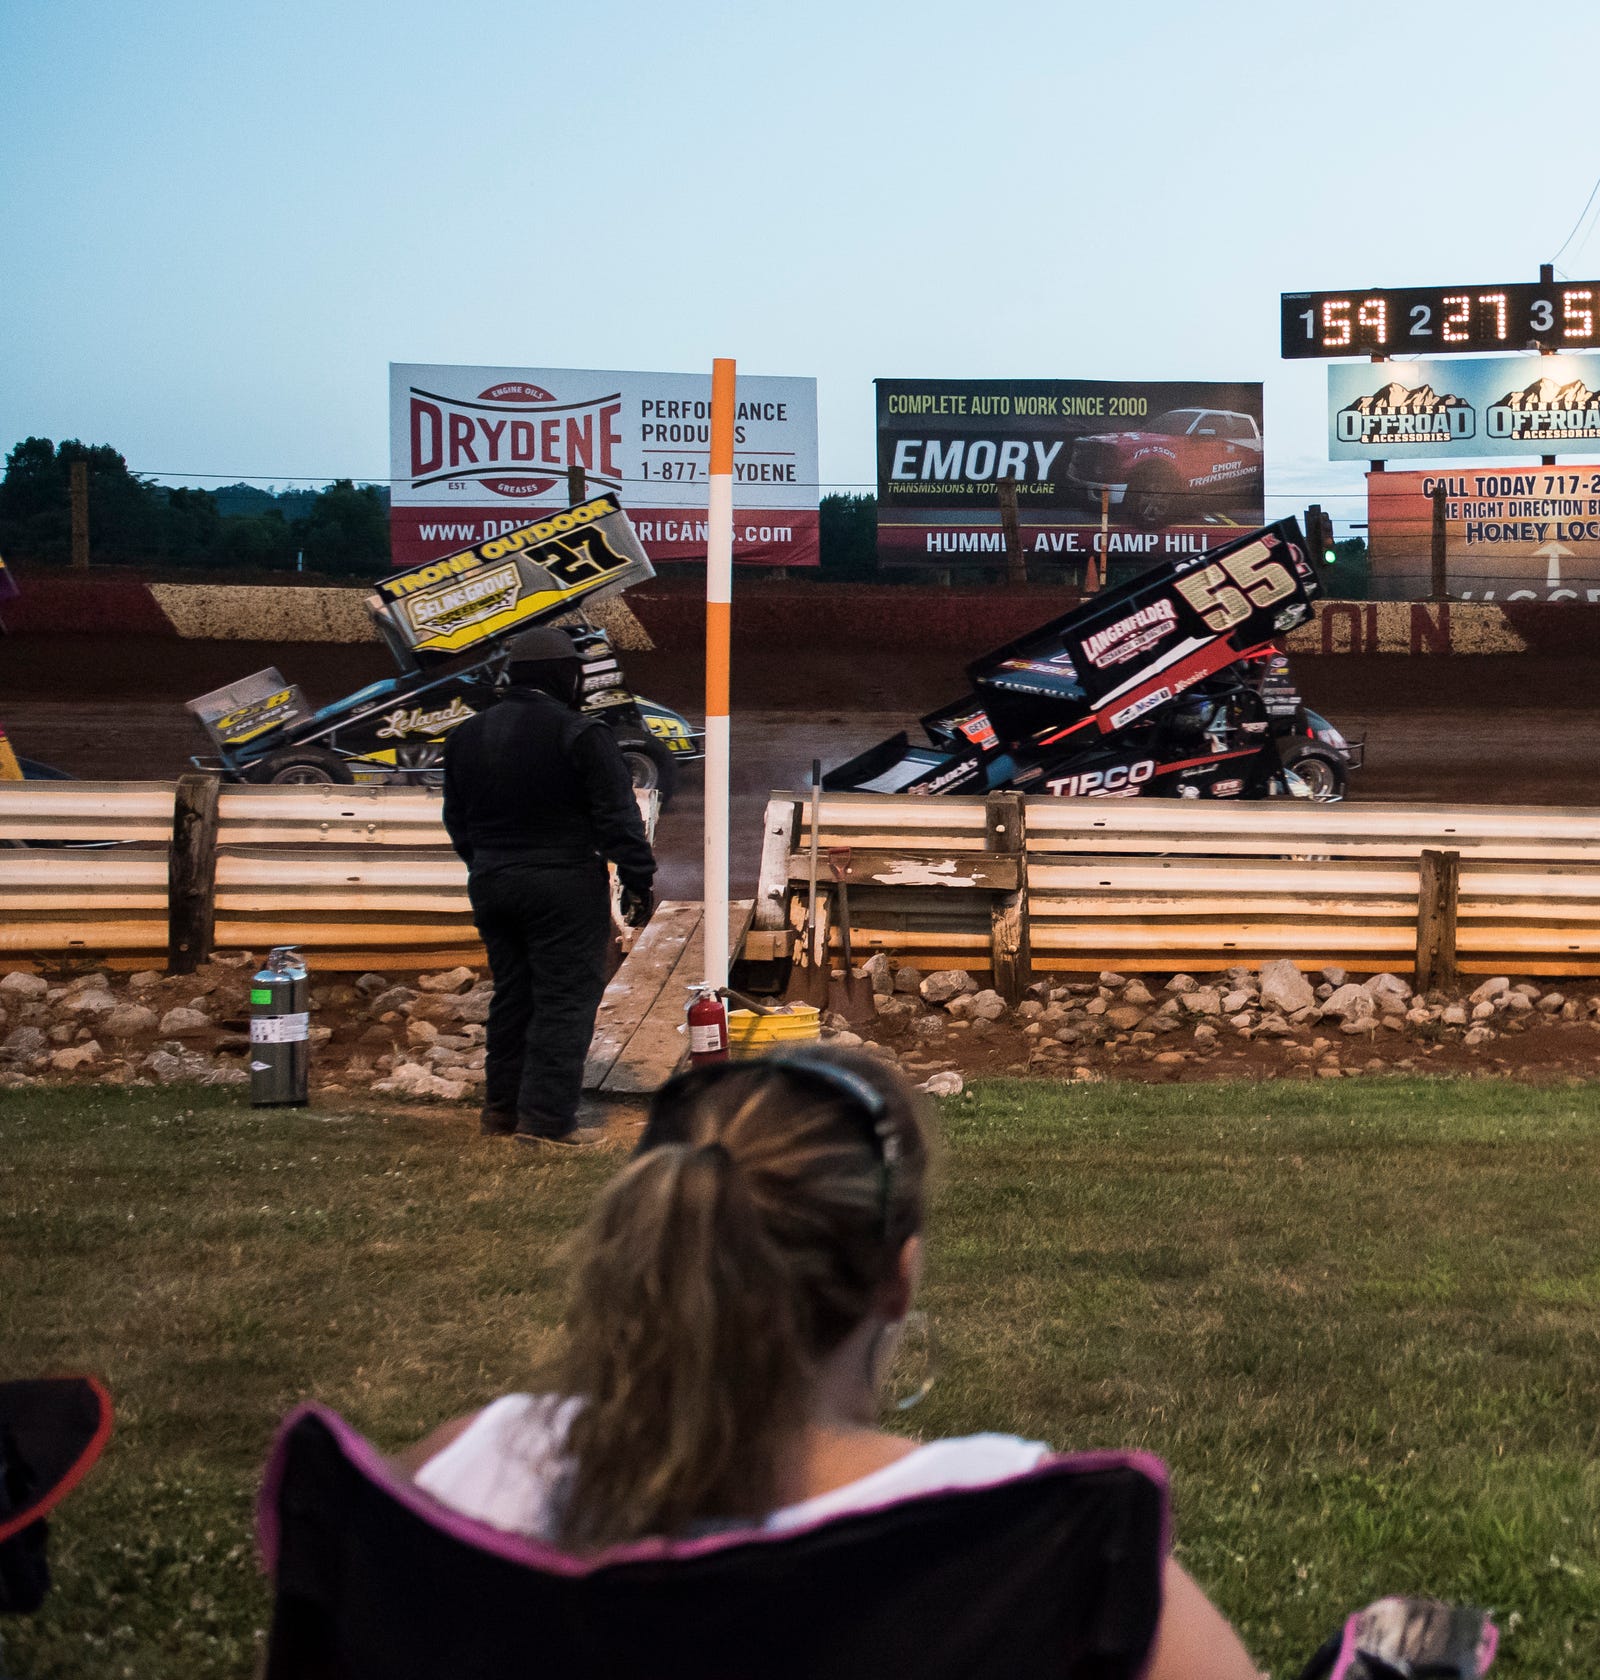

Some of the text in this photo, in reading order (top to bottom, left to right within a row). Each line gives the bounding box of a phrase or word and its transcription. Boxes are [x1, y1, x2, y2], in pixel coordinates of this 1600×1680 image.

[1300, 309, 1314, 339] 1
[1323, 299, 1386, 346] 59
[1409, 305, 1433, 335] 2
[1443, 294, 1506, 341] 27
[1530, 300, 1554, 331] 3
[492, 386, 544, 399] ENGINE OILS
[642, 400, 787, 421] PERFOANCE
[888, 395, 1147, 416] COMPLETE AUTO WORK SINCE 2000
[1361, 405, 1446, 415] HANOVER
[1512, 401, 1599, 411] HANOVER
[410, 397, 623, 479] DRYDENE
[642, 424, 746, 444] PRODUS
[1373, 433, 1450, 442] ACCESSORIES
[1512, 431, 1520, 439] &
[891, 440, 1064, 481] EMORY
[1212, 460, 1242, 473] EMORY
[641, 462, 797, 482] 1-877-YDENE
[1188, 465, 1257, 487] TRANSMISSIONS
[497, 483, 538, 493] GREASES
[888, 482, 965, 494] TRANSMISSIONS
[967, 484, 974, 494] &
[1030, 483, 1056, 494] CARE
[1423, 478, 1469, 498] CALL
[1475, 476, 1536, 497] TODAY
[1464, 502, 1503, 518] RIGHT
[1509, 499, 1583, 517] DIRECTION
[1034, 533, 1086, 552] AVE.
[1093, 534, 1158, 552] CAMP
[1165, 534, 1208, 552] HILL
[1465, 521, 1549, 545] HONEY
[384, 499, 617, 597] TRONE OUTDOOR
[521, 524, 633, 587] 27
[1080, 599, 1178, 663] LANGENFELDER
[1046, 759, 1155, 797] TIPCO
